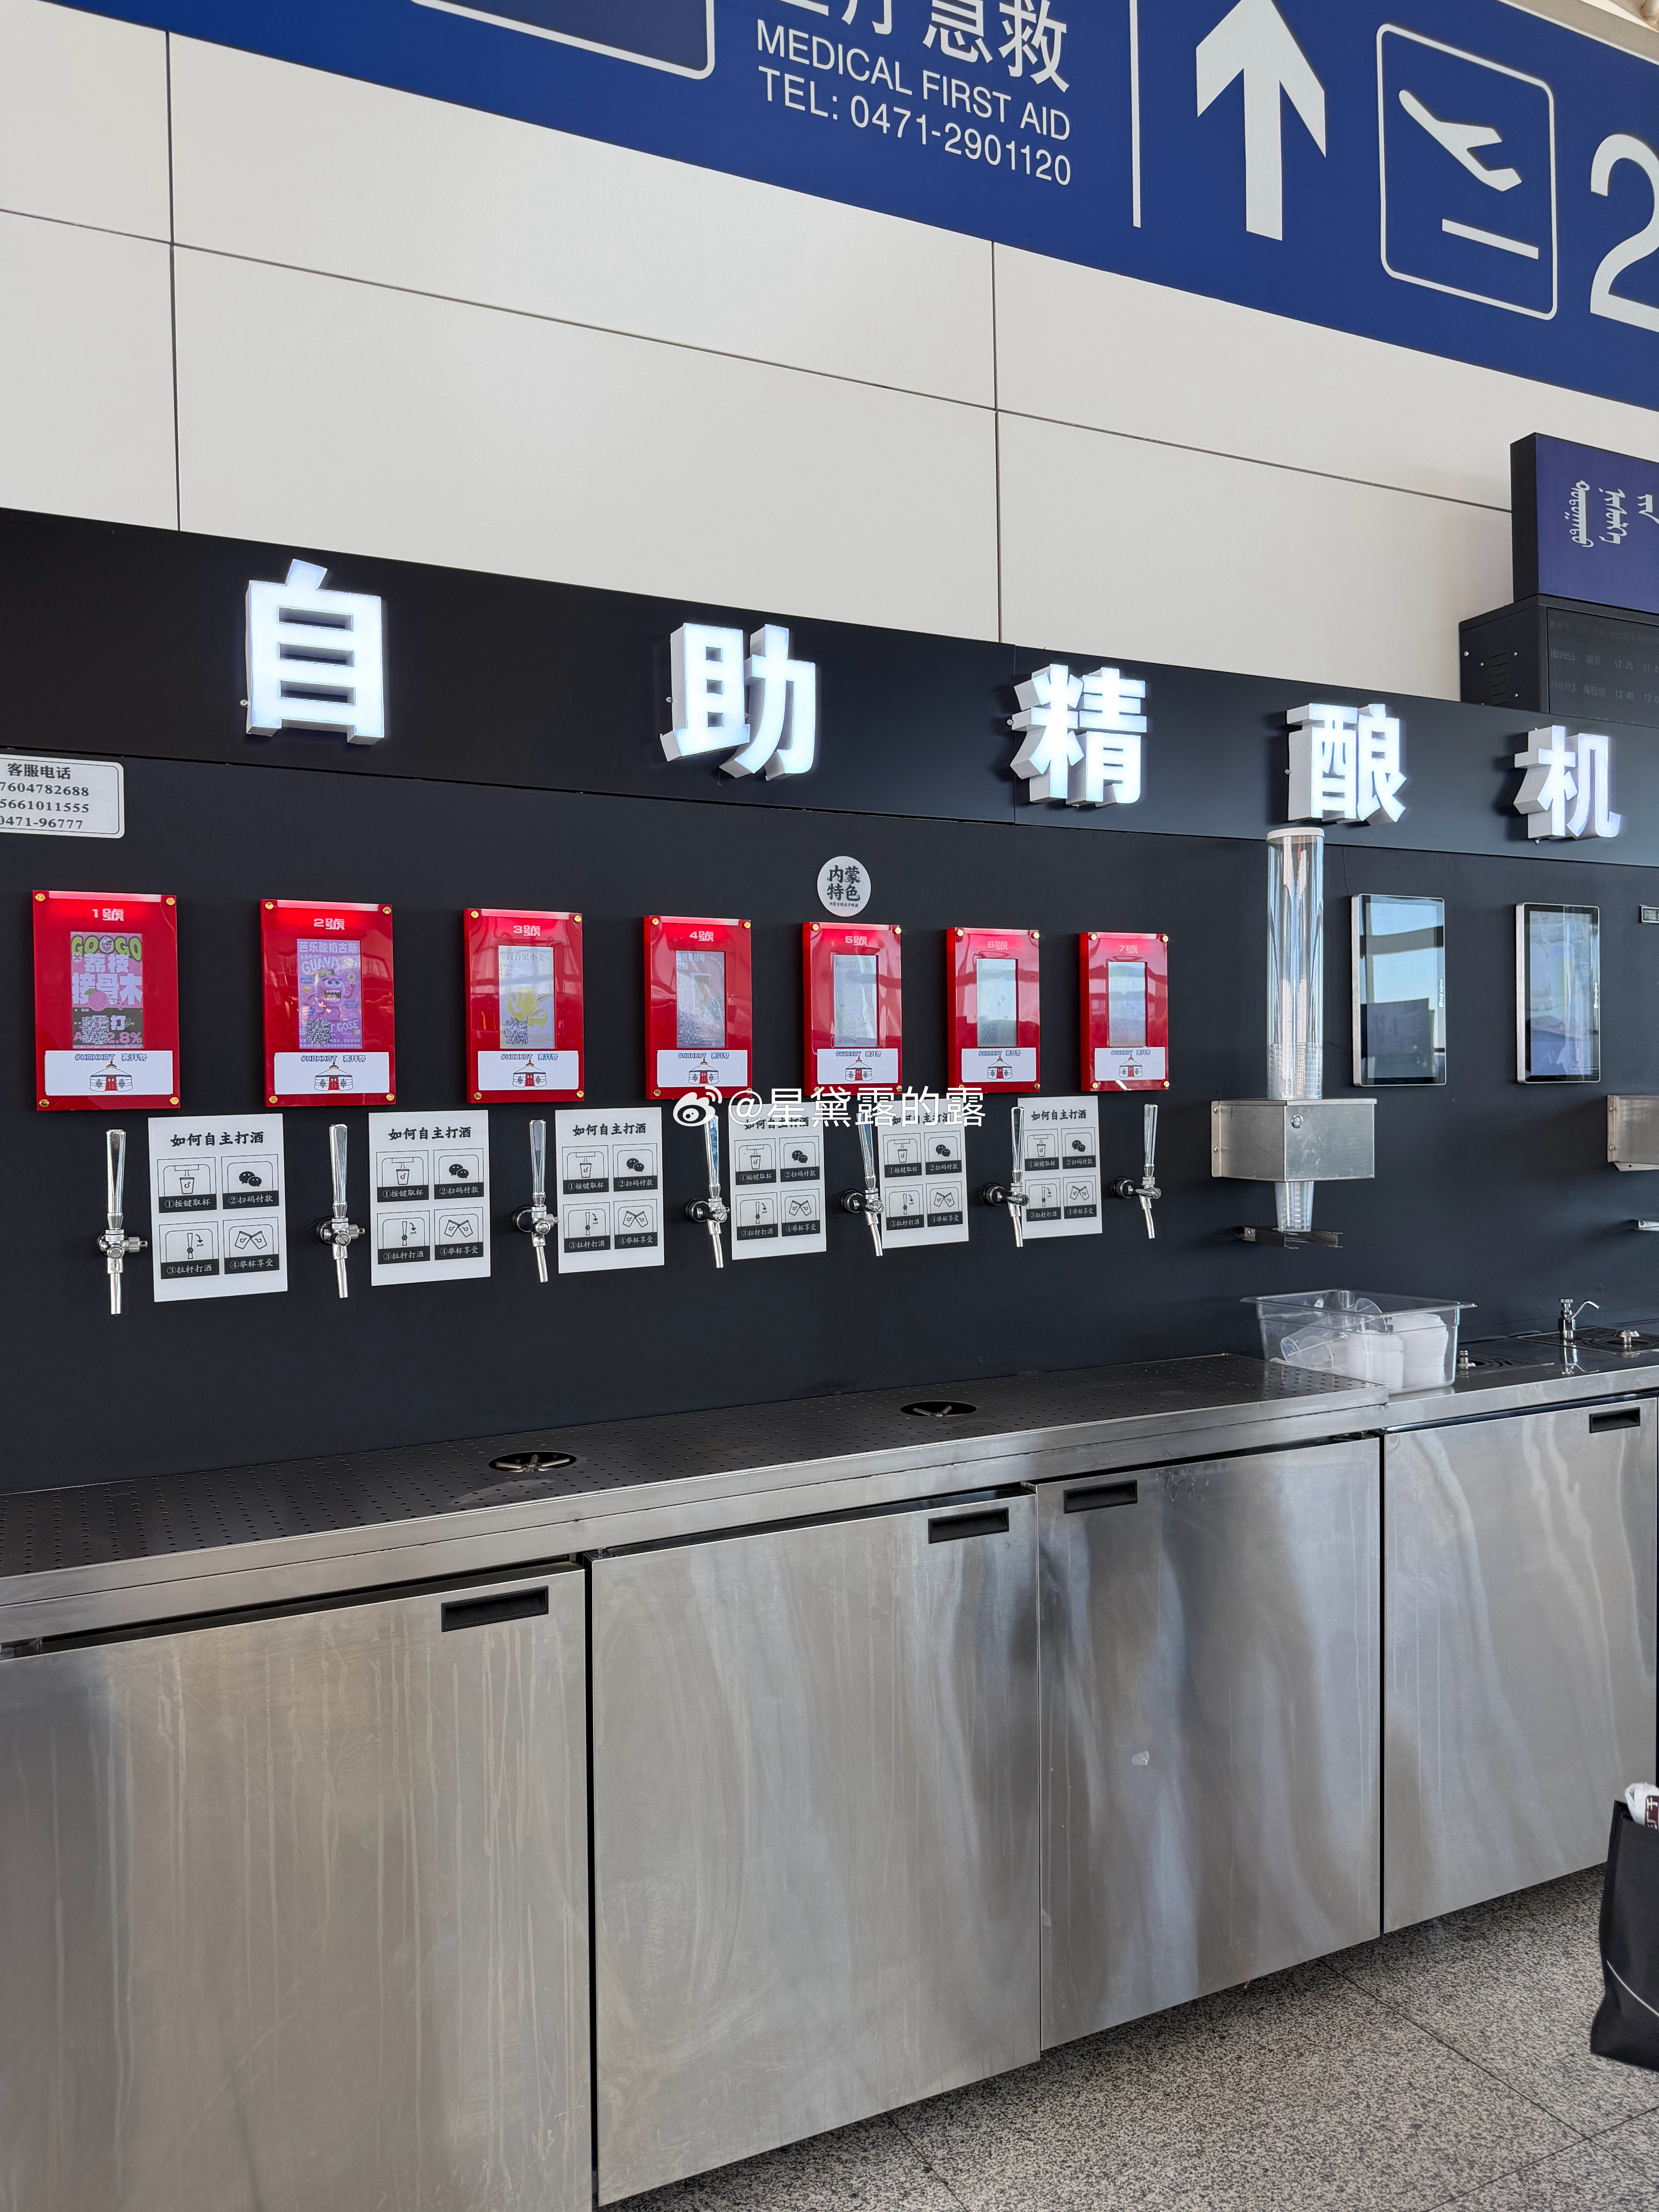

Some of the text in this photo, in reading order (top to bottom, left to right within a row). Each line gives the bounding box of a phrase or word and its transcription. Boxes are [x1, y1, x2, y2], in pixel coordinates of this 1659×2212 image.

[778, 0, 1070, 93] 急救
[757, 19, 1070, 141] MEDICAL FIRST AID
[758, 65, 1071, 186] TEL: 0471-2901120
[1590, 134, 1659, 333] 2
[1586, 655, 1601, 666] 南京
[1583, 684, 1606, 697] 海拉尔
[246, 558, 1622, 840] 自助精酿机
[7, 763, 71, 780] 客服电话
[827, 865, 861, 884] 内蒙
[827, 883, 860, 901] 特色
[314, 918, 345, 930] 2號
[513, 925, 541, 936] 3號
[689, 931, 714, 942] 4號
[299, 941, 357, 953] 芭乐酸奶古斯
[84, 953, 129, 973] 荔枝
[507, 952, 544, 961] 百香果小麦
[301, 956, 339, 974] GUAVA
[337, 1020, 359, 1032] GOSE
[1031, 1109, 1086, 1121] 如何自主打酒
[388, 1126, 472, 1140] 如何自主打酒
[572, 1123, 646, 1136] 如何自主打酒
[170, 1131, 264, 1147] 如何自主打酒
